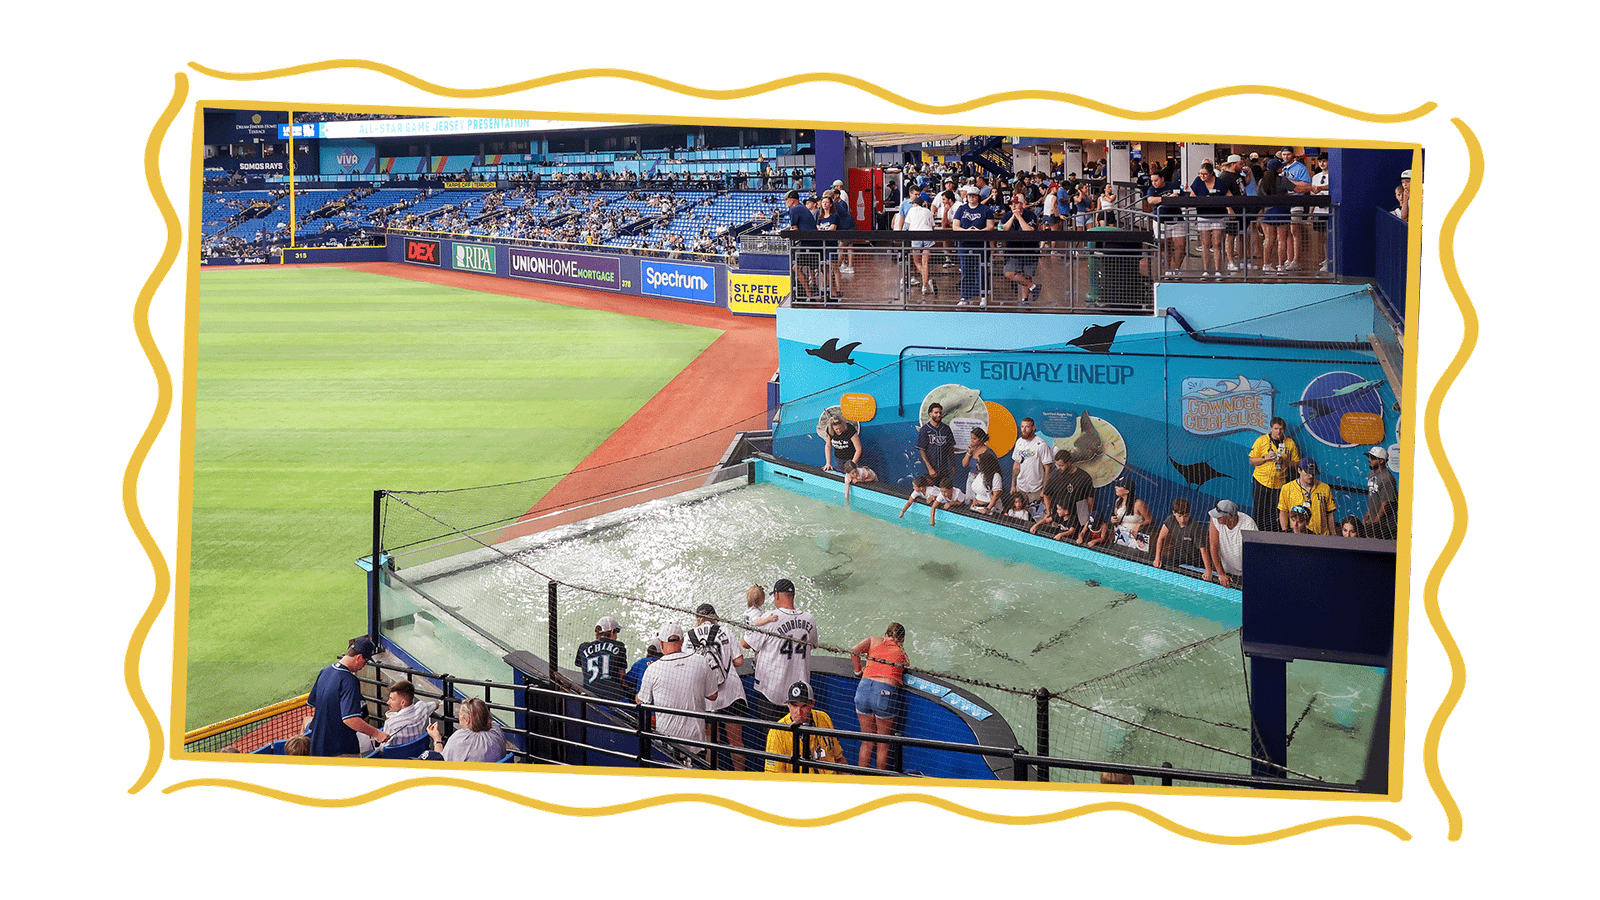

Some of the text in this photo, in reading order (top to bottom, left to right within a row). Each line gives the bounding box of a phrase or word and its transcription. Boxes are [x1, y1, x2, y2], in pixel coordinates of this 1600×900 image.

[358, 118, 530, 134] ALL-STAR GAME JERSEY PRESENTATION
[239, 162, 283, 170] SOMOS RAYS
[337, 155, 358, 164] VIVA
[408, 241, 435, 262] DEX
[465, 246, 493, 271] RIPA
[621, 279, 632, 288] 378
[646, 266, 704, 290] Spectrum
[734, 293, 785, 304] CLEARW
[915, 360, 935, 372] THE
[937, 361, 971, 373] BAY'S
[980, 360, 1062, 382] ESTUARY
[1188, 394, 1264, 416] COWNOSE
[1184, 410, 1270, 431] CLUBHOUSE
[777, 617, 813, 636] RODRÍGUEZ
[583, 642, 620, 658] ICHIRO
[780, 634, 807, 660] 44
[586, 655, 612, 684] 51
